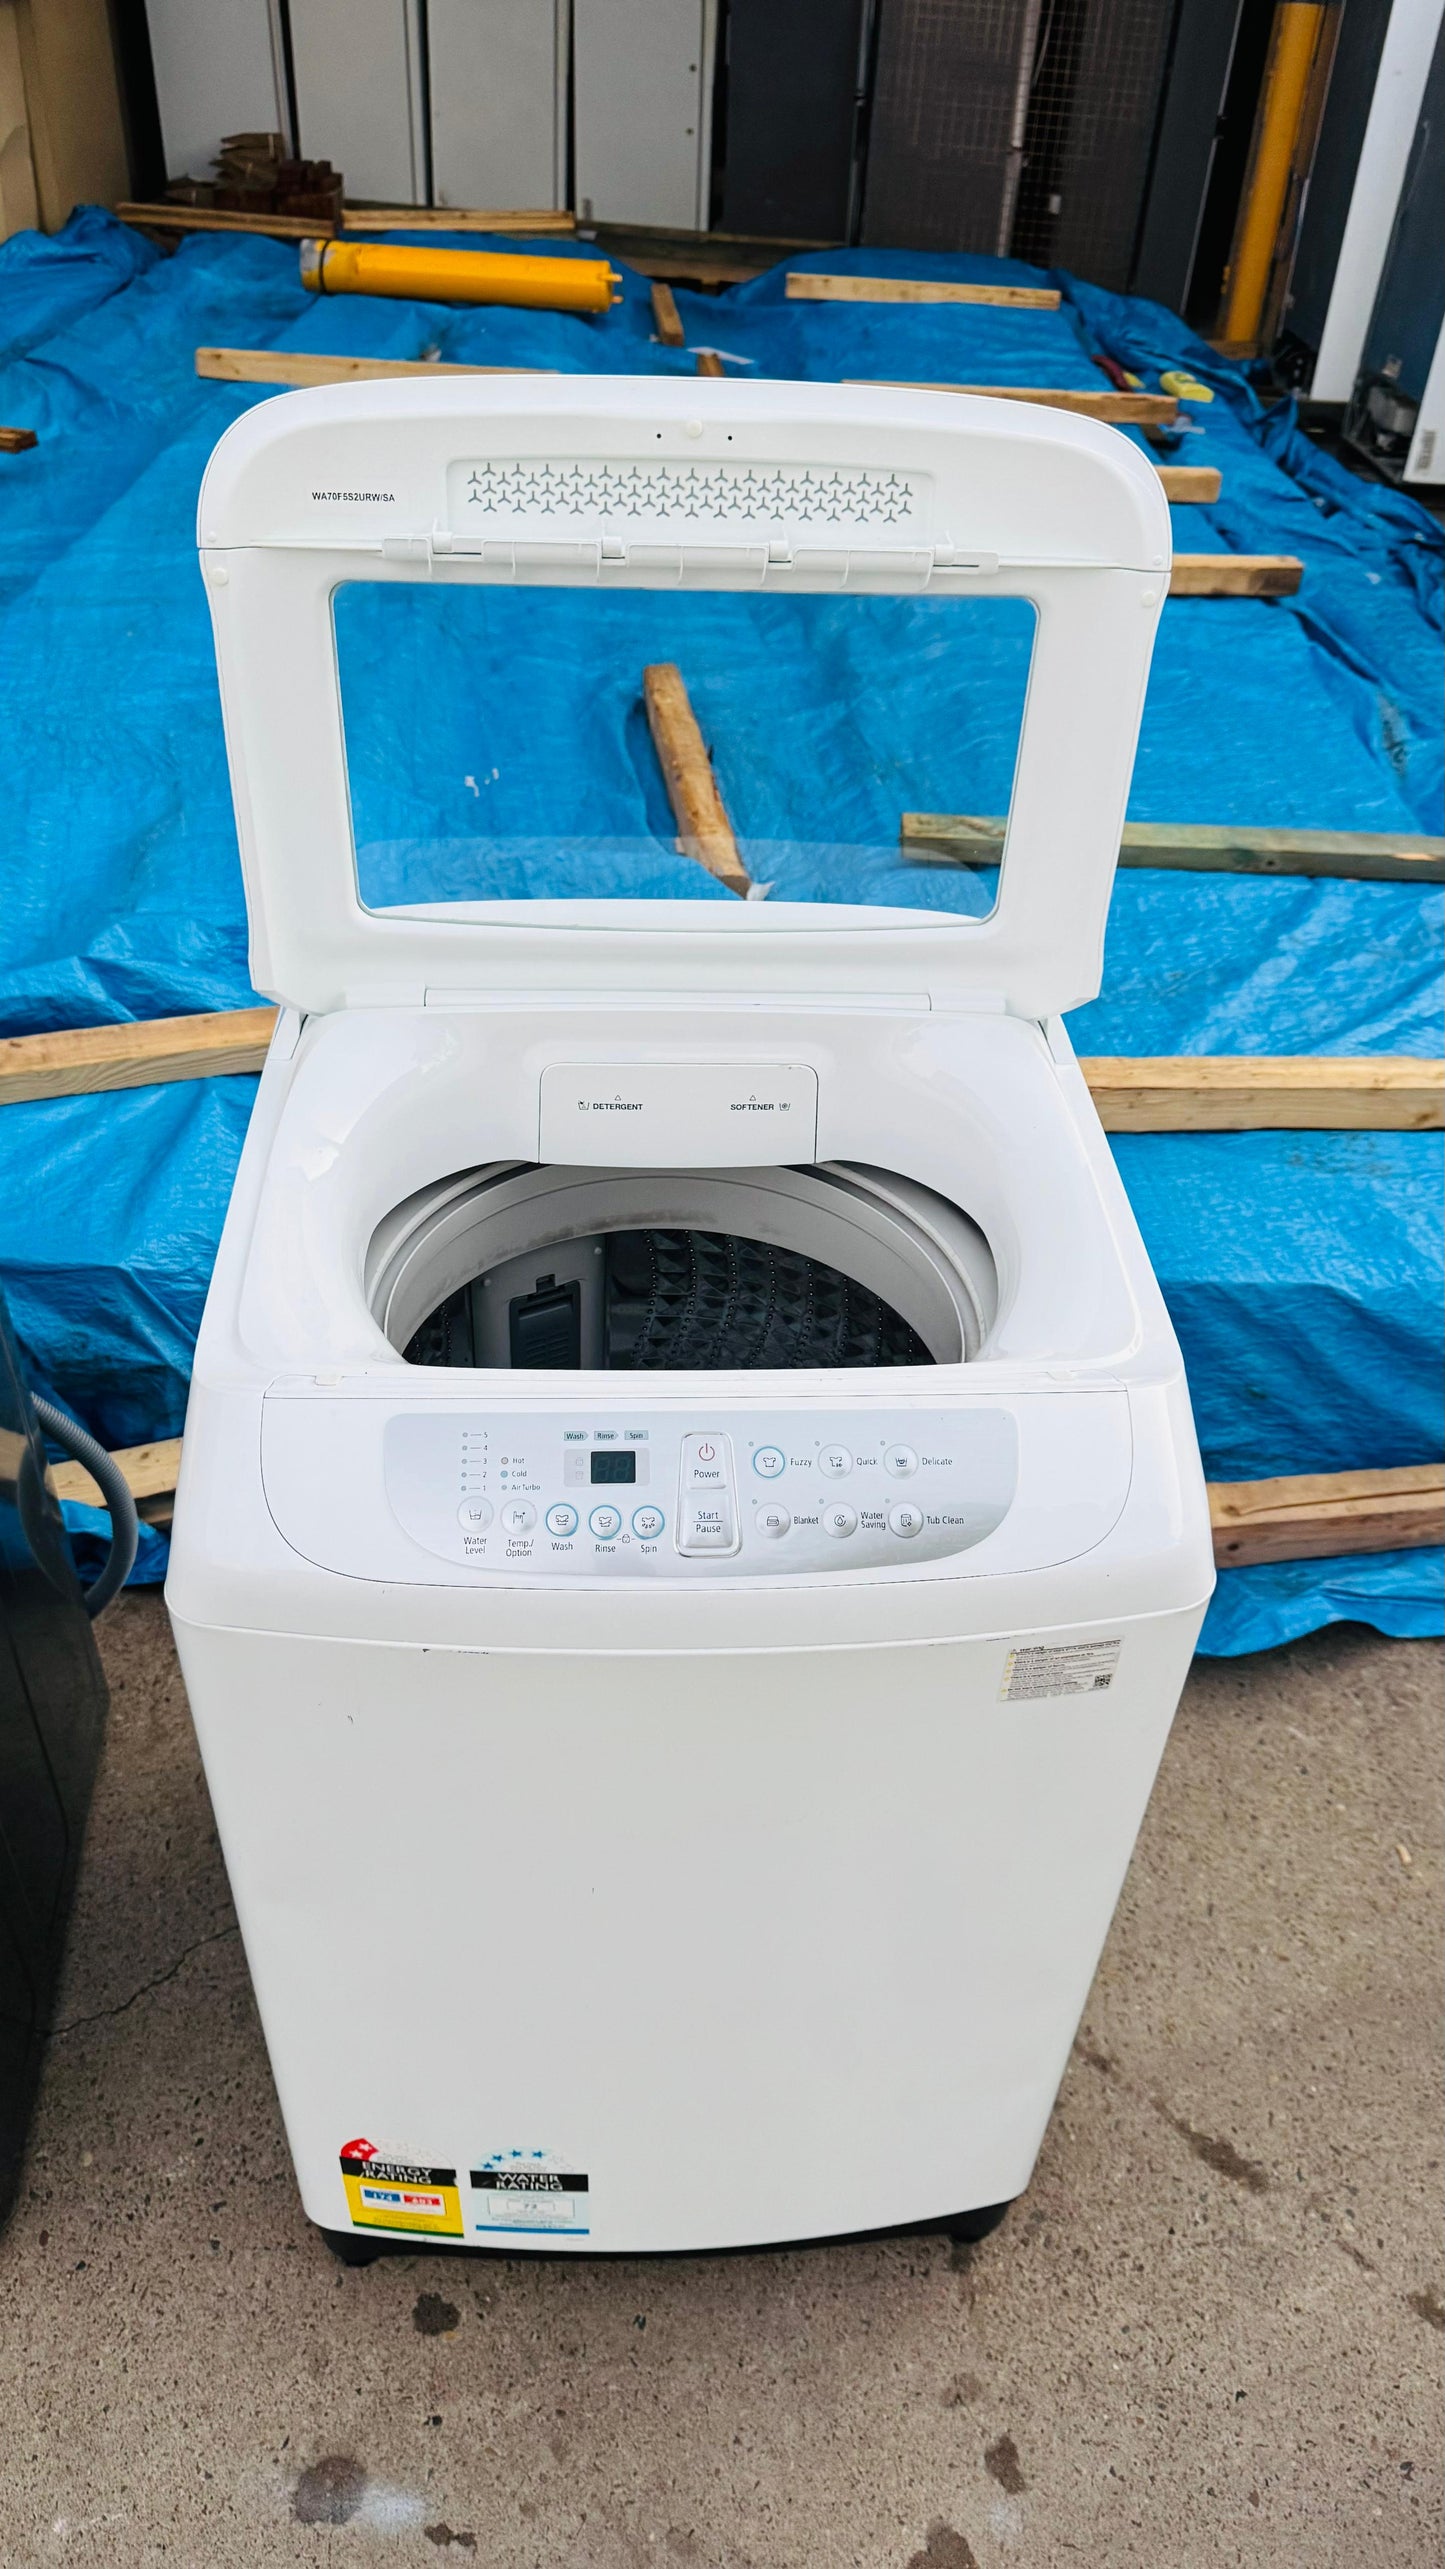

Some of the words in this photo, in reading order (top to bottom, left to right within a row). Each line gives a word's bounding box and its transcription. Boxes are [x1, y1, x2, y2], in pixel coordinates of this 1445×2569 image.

[311, 492, 396, 502] WA70F5S2URW/SA
[730, 1103, 775, 1111] SOFTENER
[483, 1431, 488, 1439] 5
[597, 1432, 615, 1440] Rinse
[629, 1432, 644, 1440] Spin
[790, 1458, 812, 1468] Fuzzy
[856, 1457, 877, 1466] Quick
[922, 1457, 953, 1466] Delicate
[694, 1469, 720, 1478] Power
[522, 1483, 541, 1491] Turbo
[697, 1510, 719, 1520] Start
[793, 1516, 819, 1524] Blanket
[861, 1511, 883, 1520] Water
[926, 1515, 940, 1524] Tub
[942, 1515, 965, 1525] Clean
[696, 1523, 721, 1533] Pause
[861, 1520, 886, 1530] Saving
[463, 1536, 487, 1545] Water
[508, 1538, 534, 1549] Temp./
[465, 1545, 486, 1555] Level
[551, 1541, 574, 1551] Wash
[595, 1544, 616, 1553] Rinse
[640, 1544, 658, 1554] Spin
[505, 1548, 532, 1557] Option
[362, 2160, 432, 2177] ENERGY
[365, 2169, 432, 2185] RATING
[498, 2173, 560, 2183] WATER
[496, 2180, 564, 2192] RATING
